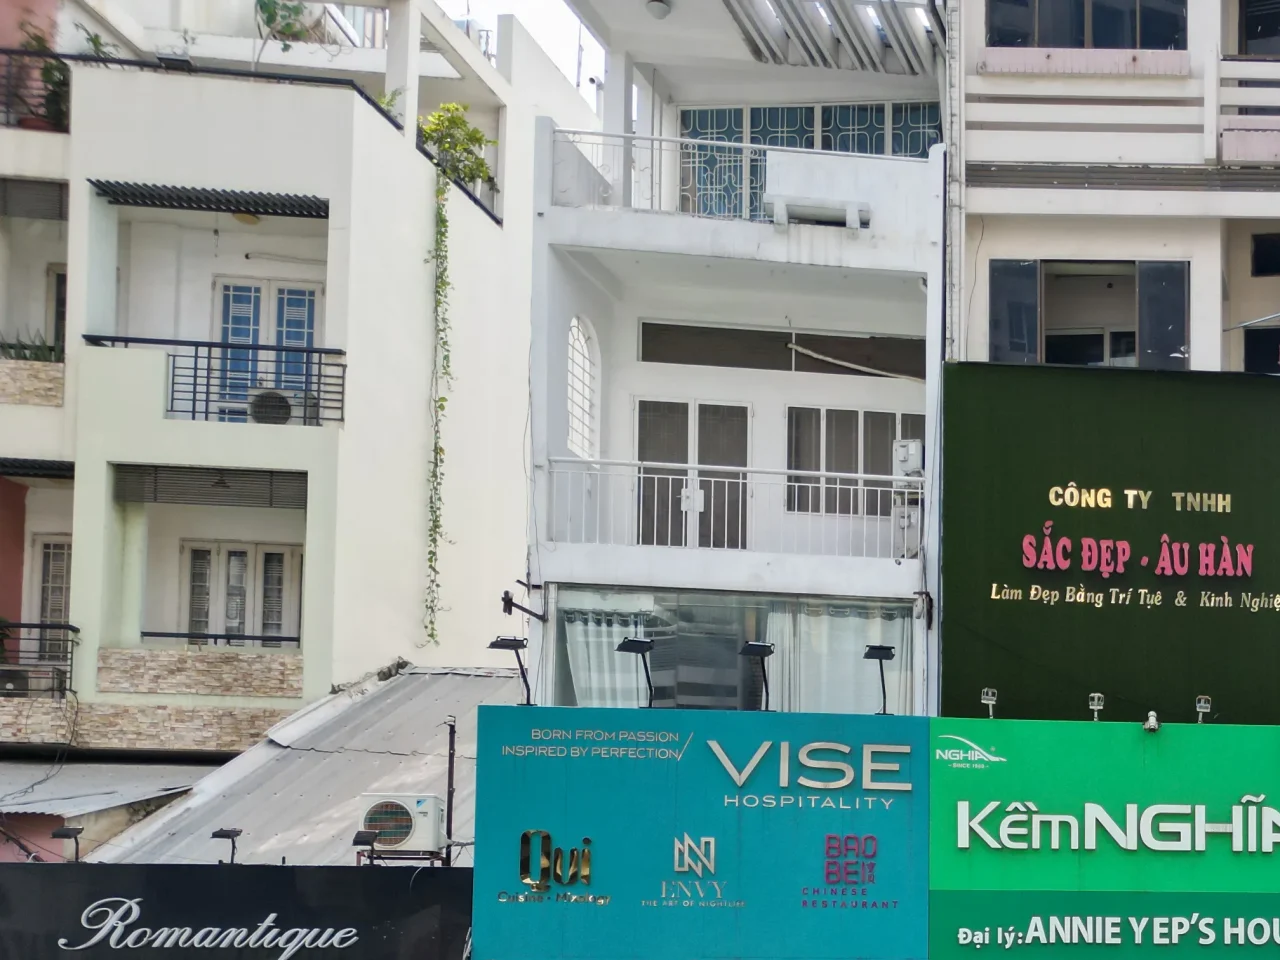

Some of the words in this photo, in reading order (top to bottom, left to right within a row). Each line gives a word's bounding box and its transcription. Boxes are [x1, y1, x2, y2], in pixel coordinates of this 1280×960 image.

[1048, 481, 1112, 508] CÔNG
[1124, 489, 1152, 510] TY
[1171, 491, 1232, 513] TNHH
[1022, 520, 1072, 571] SẮC
[1081, 537, 1131, 578] ĐẸP
[1154, 533, 1190, 577] ÂU
[1198, 535, 1254, 578] HÀN
[990, 583, 1022, 601] Làm
[1029, 585, 1059, 606] Đẹp
[1064, 584, 1103, 608] Bằng
[1109, 587, 1133, 605] Trí
[1137, 588, 1163, 608] Tuệ
[1175, 592, 1187, 607] &
[1200, 591, 1233, 608] Kinh
[531, 729, 572, 740] BORN
[574, 729, 616, 741] FROM
[619, 730, 679, 742] PASSION
[502, 746, 567, 758] INSPIRED
[569, 746, 588, 757] BY
[591, 746, 678, 759] PERFECTION
[706, 740, 912, 791] VISE
[724, 795, 894, 810] HOSPITALITY
[825, 834, 877, 859] BAO
[519, 829, 592, 891] Qui
[825, 860, 865, 885] BEI
[498, 891, 544, 903] Cuisine
[556, 892, 611, 906] Mixology
[661, 881, 727, 899] ENVY
[802, 888, 867, 896] CHINESE
[802, 900, 899, 909] RESTAURANT
[957, 927, 990, 950] Đại
[1025, 916, 1121, 944] ANNIE
